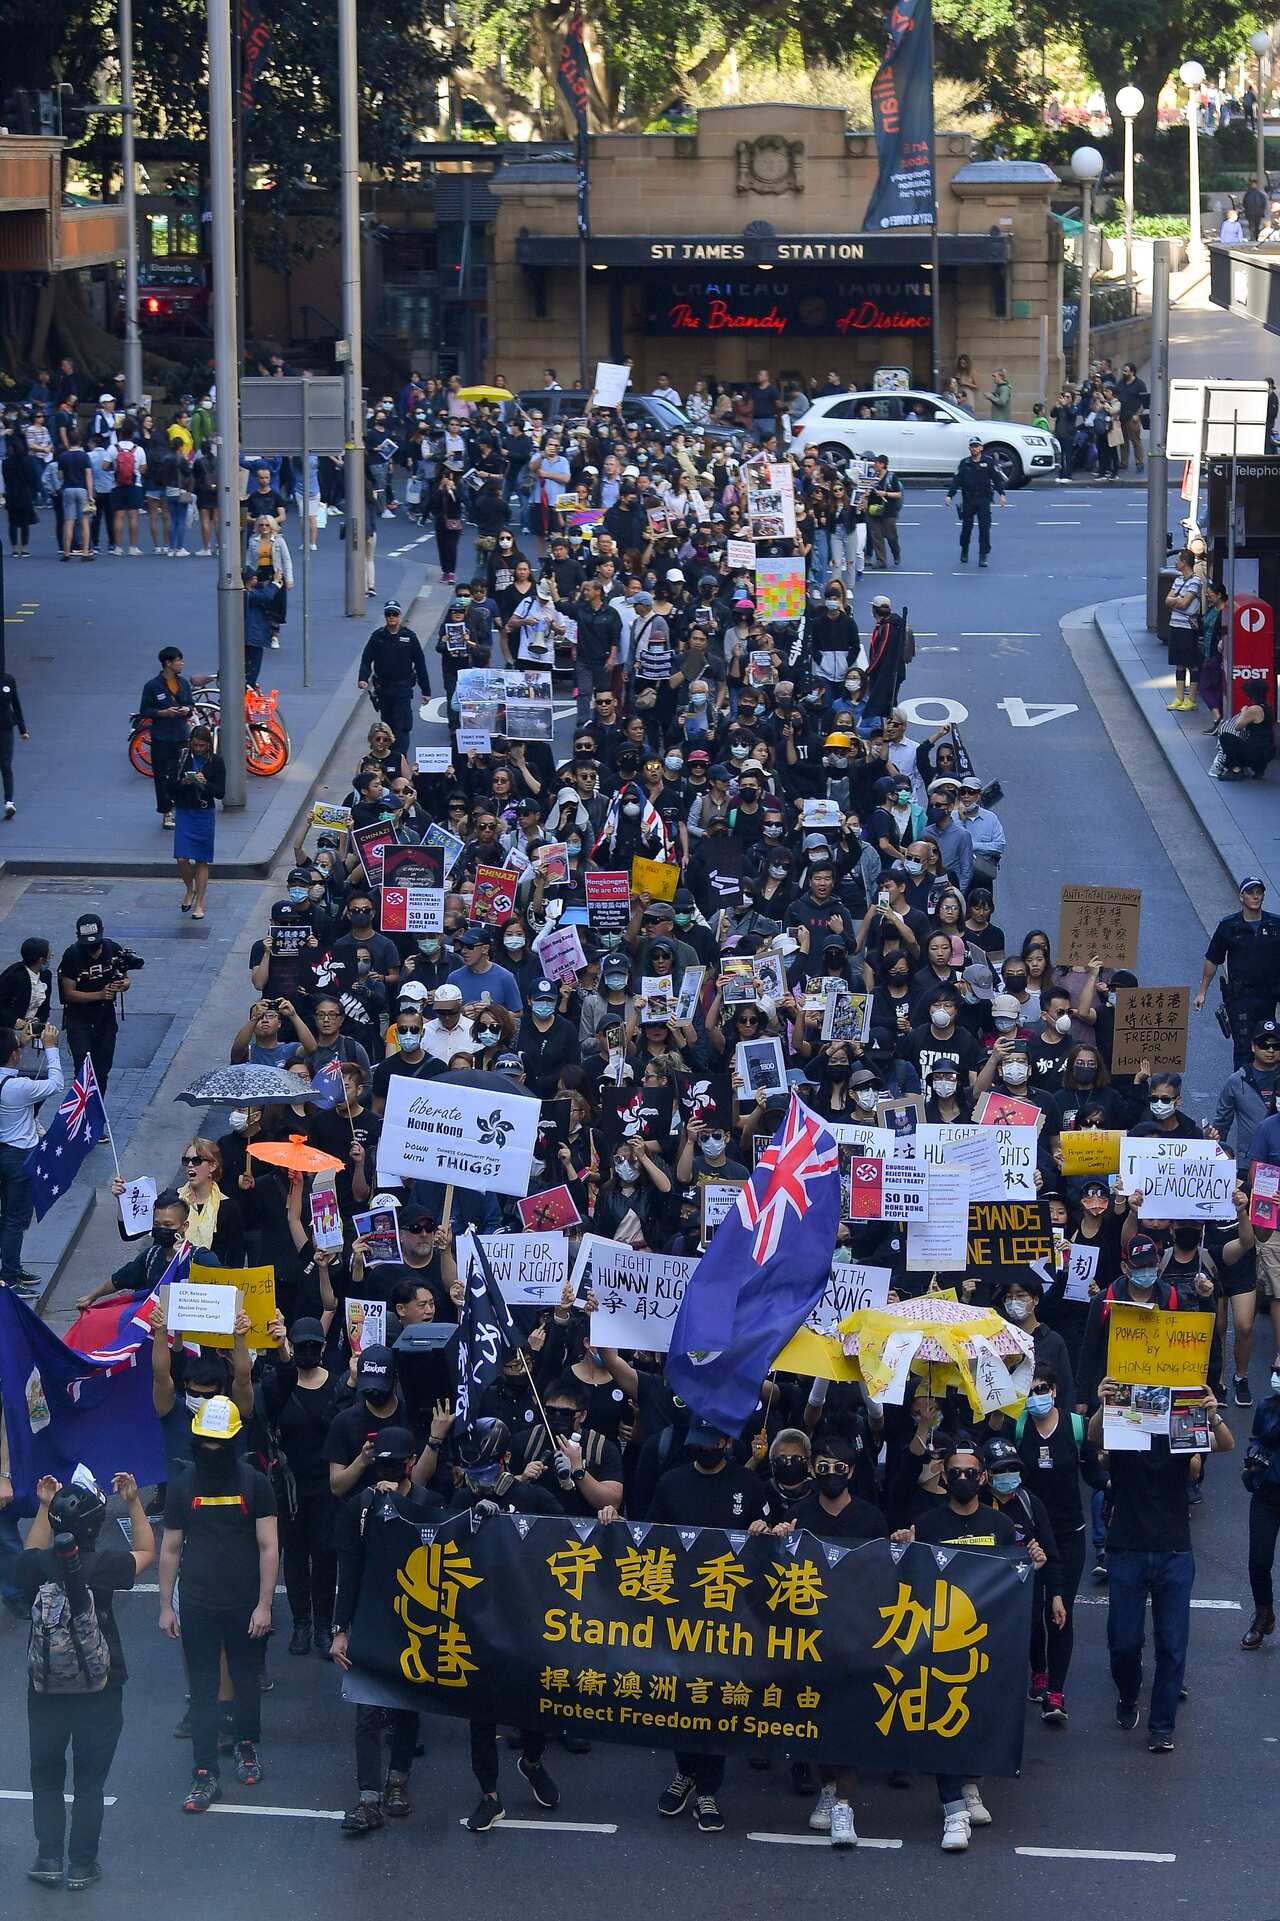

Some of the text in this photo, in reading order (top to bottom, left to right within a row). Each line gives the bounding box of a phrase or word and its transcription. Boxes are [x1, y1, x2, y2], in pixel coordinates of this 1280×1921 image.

[651, 244, 864, 259] ST JAMES STATION
[668, 303, 700, 328] The
[708, 300, 788, 334] Brandy
[1235, 465, 1280, 479] Telepho
[1232, 668, 1269, 680] POST
[360, 827, 390, 841] CHINAZI
[478, 867, 517, 883] CHINAZI
[423, 912, 436, 920] DO
[1124, 1011, 1179, 1029] 時代革命
[1124, 1030, 1178, 1042] FREEDOM
[1141, 1042, 1161, 1053] FOR
[1118, 1055, 1182, 1067] HONG KONG
[408, 1096, 463, 1121] liberate
[407, 1117, 464, 1138] Hong Kong
[854, 1129, 875, 1144] FOR
[995, 1129, 1014, 1145] OR
[404, 1141, 429, 1153] DOWN
[1158, 1143, 1188, 1157] STOP
[403, 1152, 425, 1163] WITH
[1000, 1147, 1030, 1166] GHTS
[1158, 1162, 1216, 1177] WE WANT
[1144, 1177, 1231, 1200] DEMOCRACY
[885, 1193, 920, 1204] SO DO
[969, 1204, 1041, 1231] EMANDS
[525, 1243, 553, 1261] FOR
[966, 1237, 1053, 1265] NE LESS
[518, 1261, 564, 1283] RIGHTS
[615, 1254, 690, 1280] FIGHT FOR
[598, 1267, 688, 1299] HUMAN RIG
[363, 1304, 382, 1317] 9.29
[1147, 1346, 1160, 1357] BY
[1118, 1360, 1151, 1375] HONG
[1156, 1360, 1180, 1374] KONG
[546, 1539, 828, 1616] 守護香港
[543, 1608, 824, 1662] Stand With HK
[539, 1698, 818, 1739] Protect Freedom of Speech
